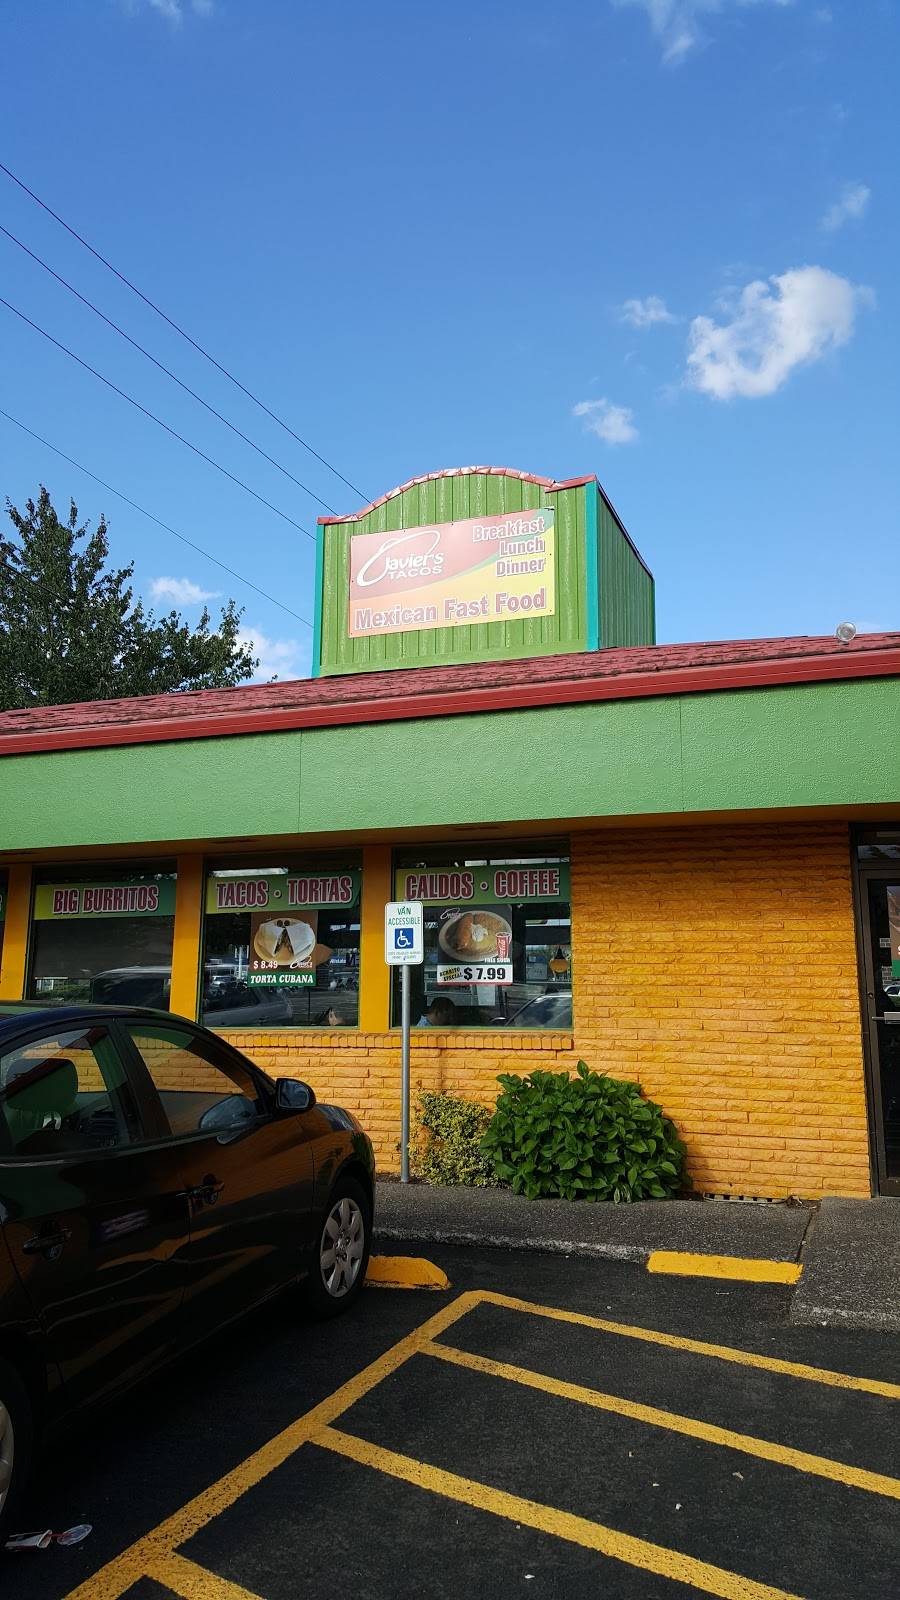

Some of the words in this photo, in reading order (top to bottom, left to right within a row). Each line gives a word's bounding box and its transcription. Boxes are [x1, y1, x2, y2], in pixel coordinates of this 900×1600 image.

[473, 517, 545, 542] Breakfast
[500, 536, 545, 557] Lunch
[388, 565, 443, 580] TACOS
[496, 557, 545, 577] Dinner
[355, 604, 437, 630] Mexican
[444, 595, 488, 619] Fast
[495, 588, 546, 614] Food
[216, 879, 269, 909] TACOS
[288, 875, 353, 906] TORTAS
[405, 872, 474, 900] CALDOS
[494, 868, 560, 898] COFFEE
[53, 888, 80, 914] BIG
[83, 885, 159, 913] BURRITOS
[388, 916, 421, 926] ACCESSIBLE
[397, 907, 412, 916] VAN
[260, 960, 279, 969] 8.49
[476, 967, 506, 980] 7.99
[250, 974, 277, 984] TORTA
[278, 974, 314, 984] CUBANA
